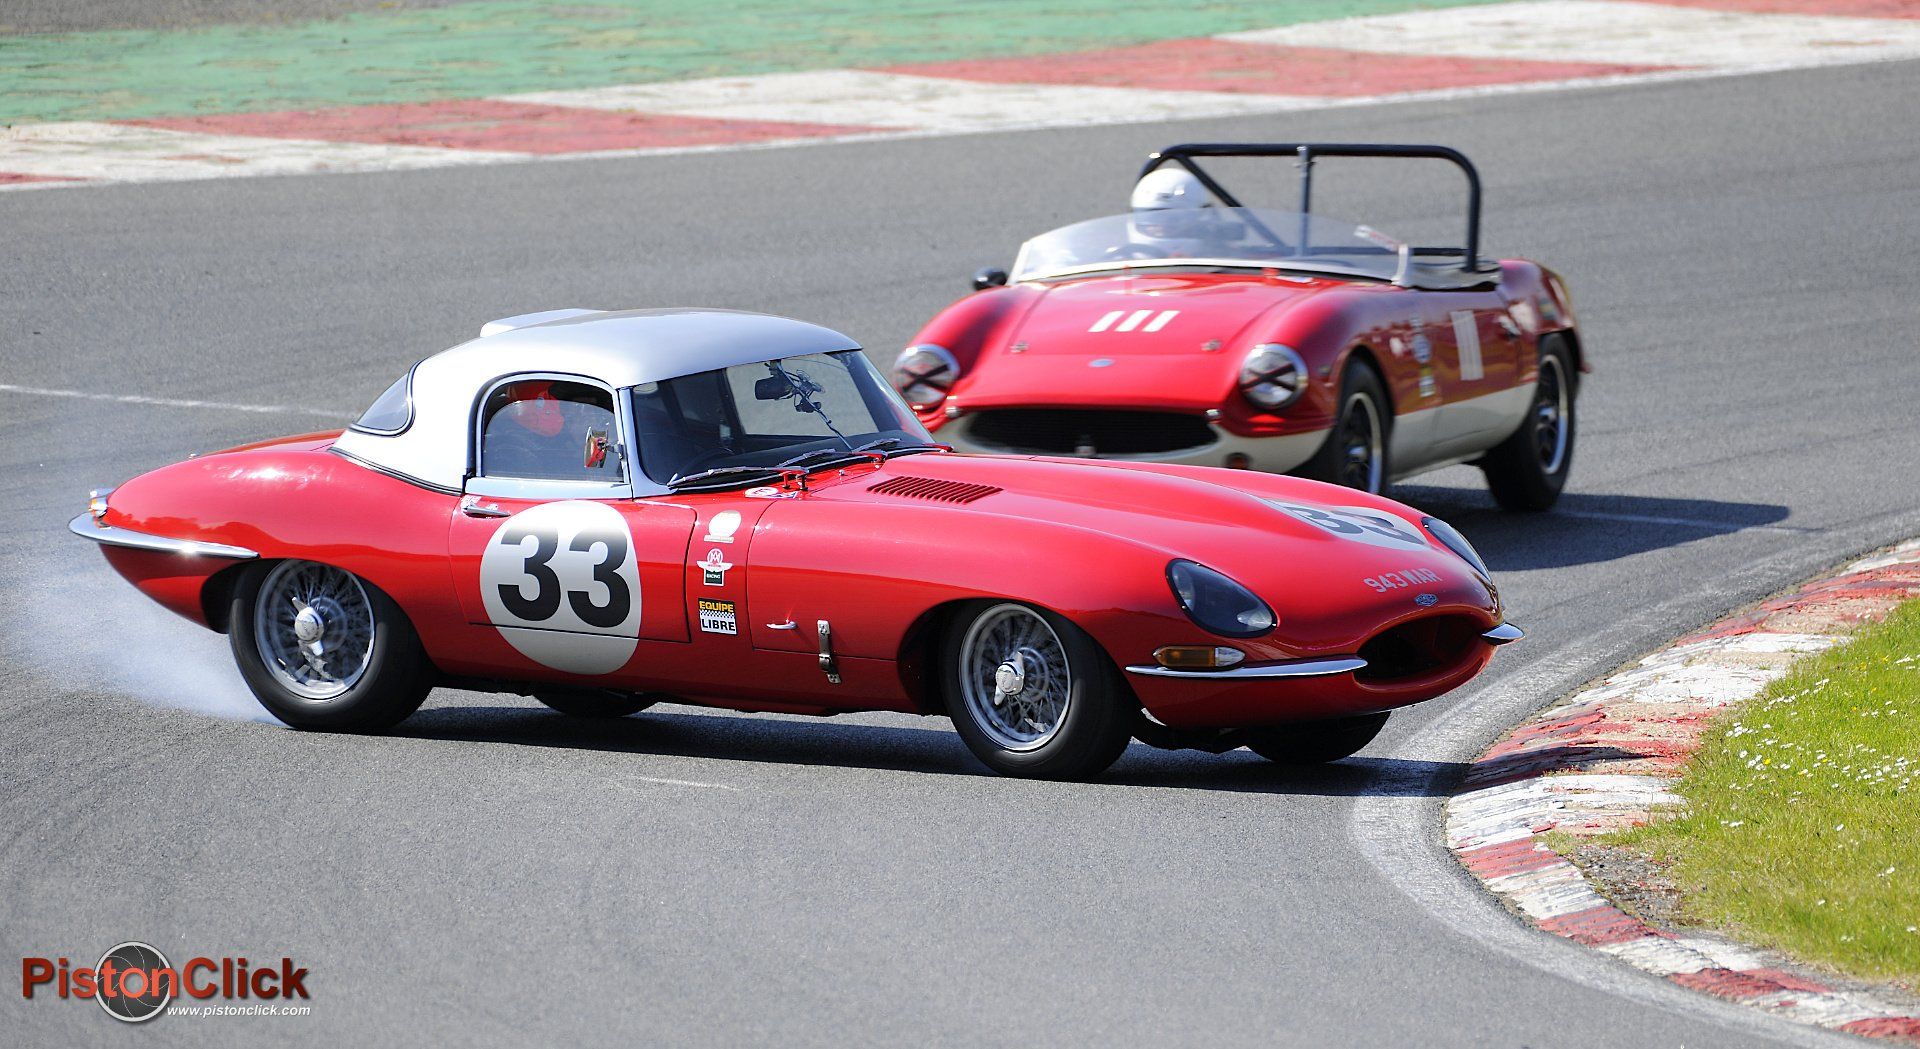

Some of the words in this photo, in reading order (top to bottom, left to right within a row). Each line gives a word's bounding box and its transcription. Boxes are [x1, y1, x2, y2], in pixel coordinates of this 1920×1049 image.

[1088, 310, 1180, 333] 111
[1283, 506, 1426, 545] 33
[498, 525, 631, 628] 33
[1363, 572, 1408, 593] 943
[699, 600, 734, 612] EQUIPE
[701, 618, 736, 632] LIBRE
